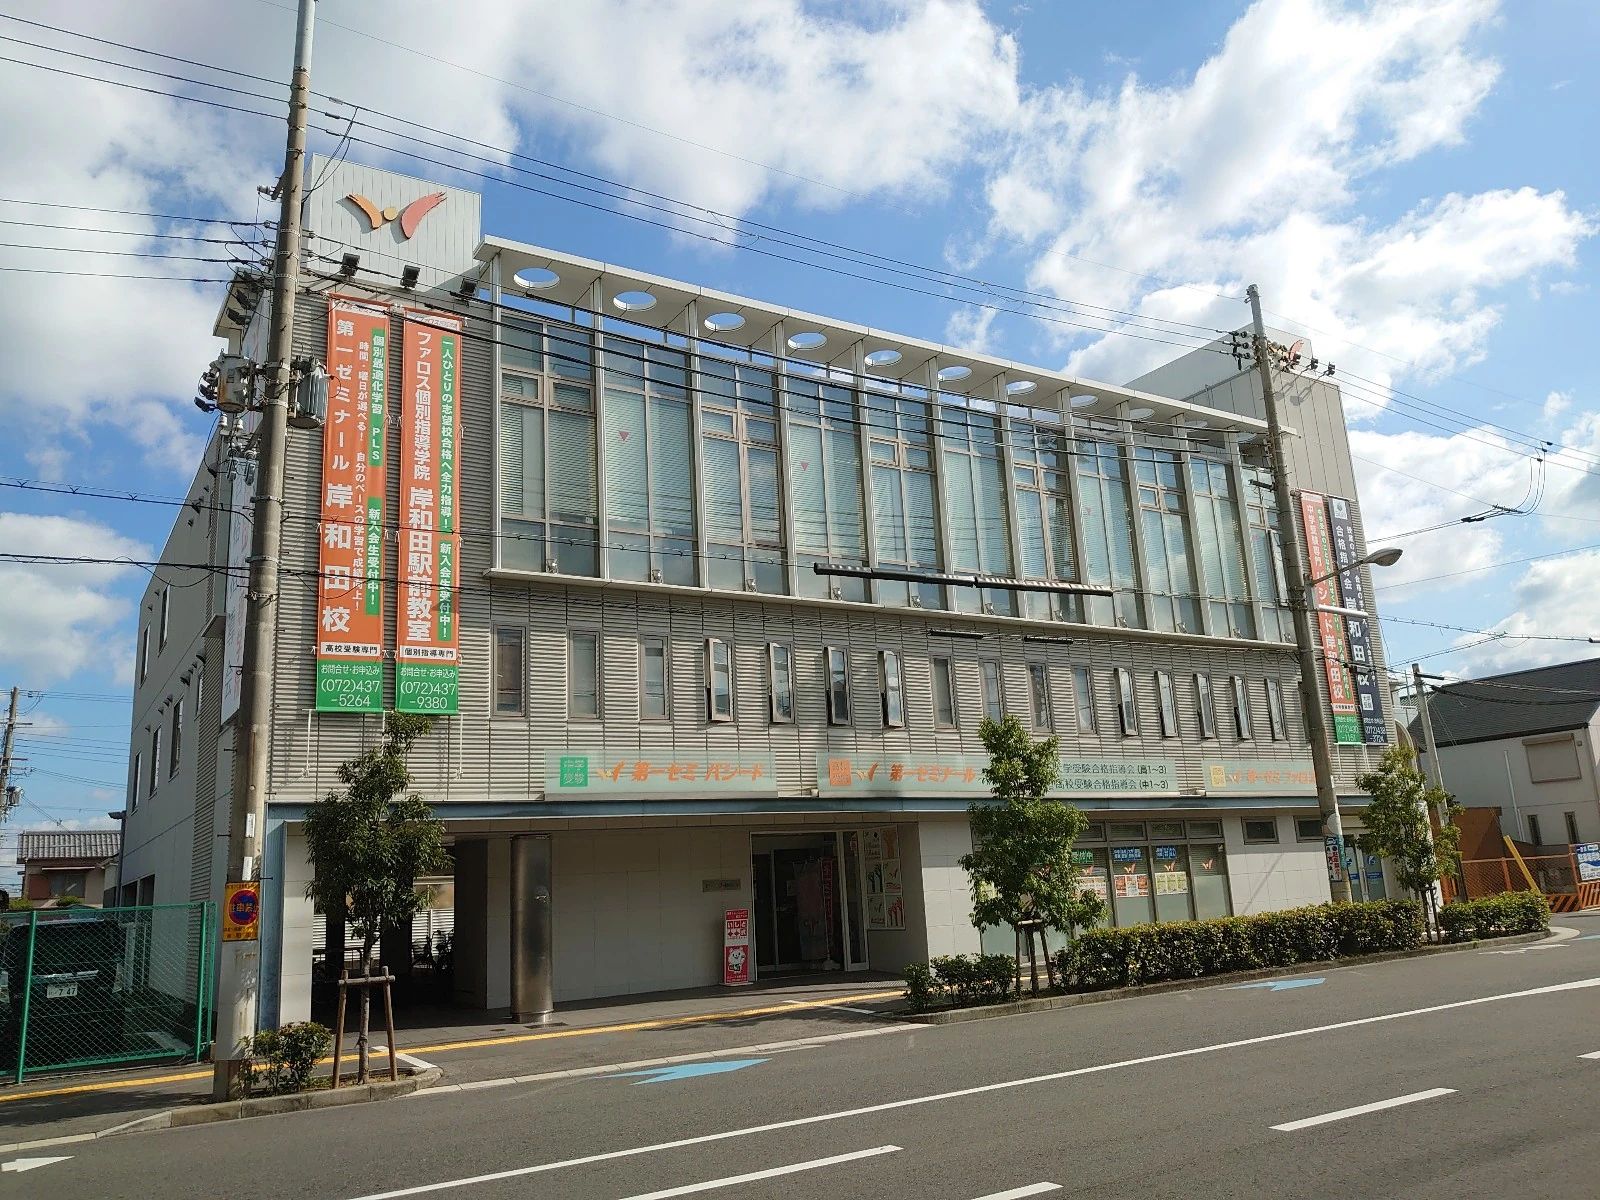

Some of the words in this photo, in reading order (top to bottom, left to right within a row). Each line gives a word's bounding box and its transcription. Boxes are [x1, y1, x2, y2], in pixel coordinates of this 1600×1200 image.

[332, 319, 355, 471] 第一ゼミナール
[322, 483, 353, 633] 岸和田校
[321, 678, 380, 693] (072)437
[400, 681, 457, 695] (072)437
[331, 694, 371, 707] -5264
[409, 697, 448, 709] -9380
